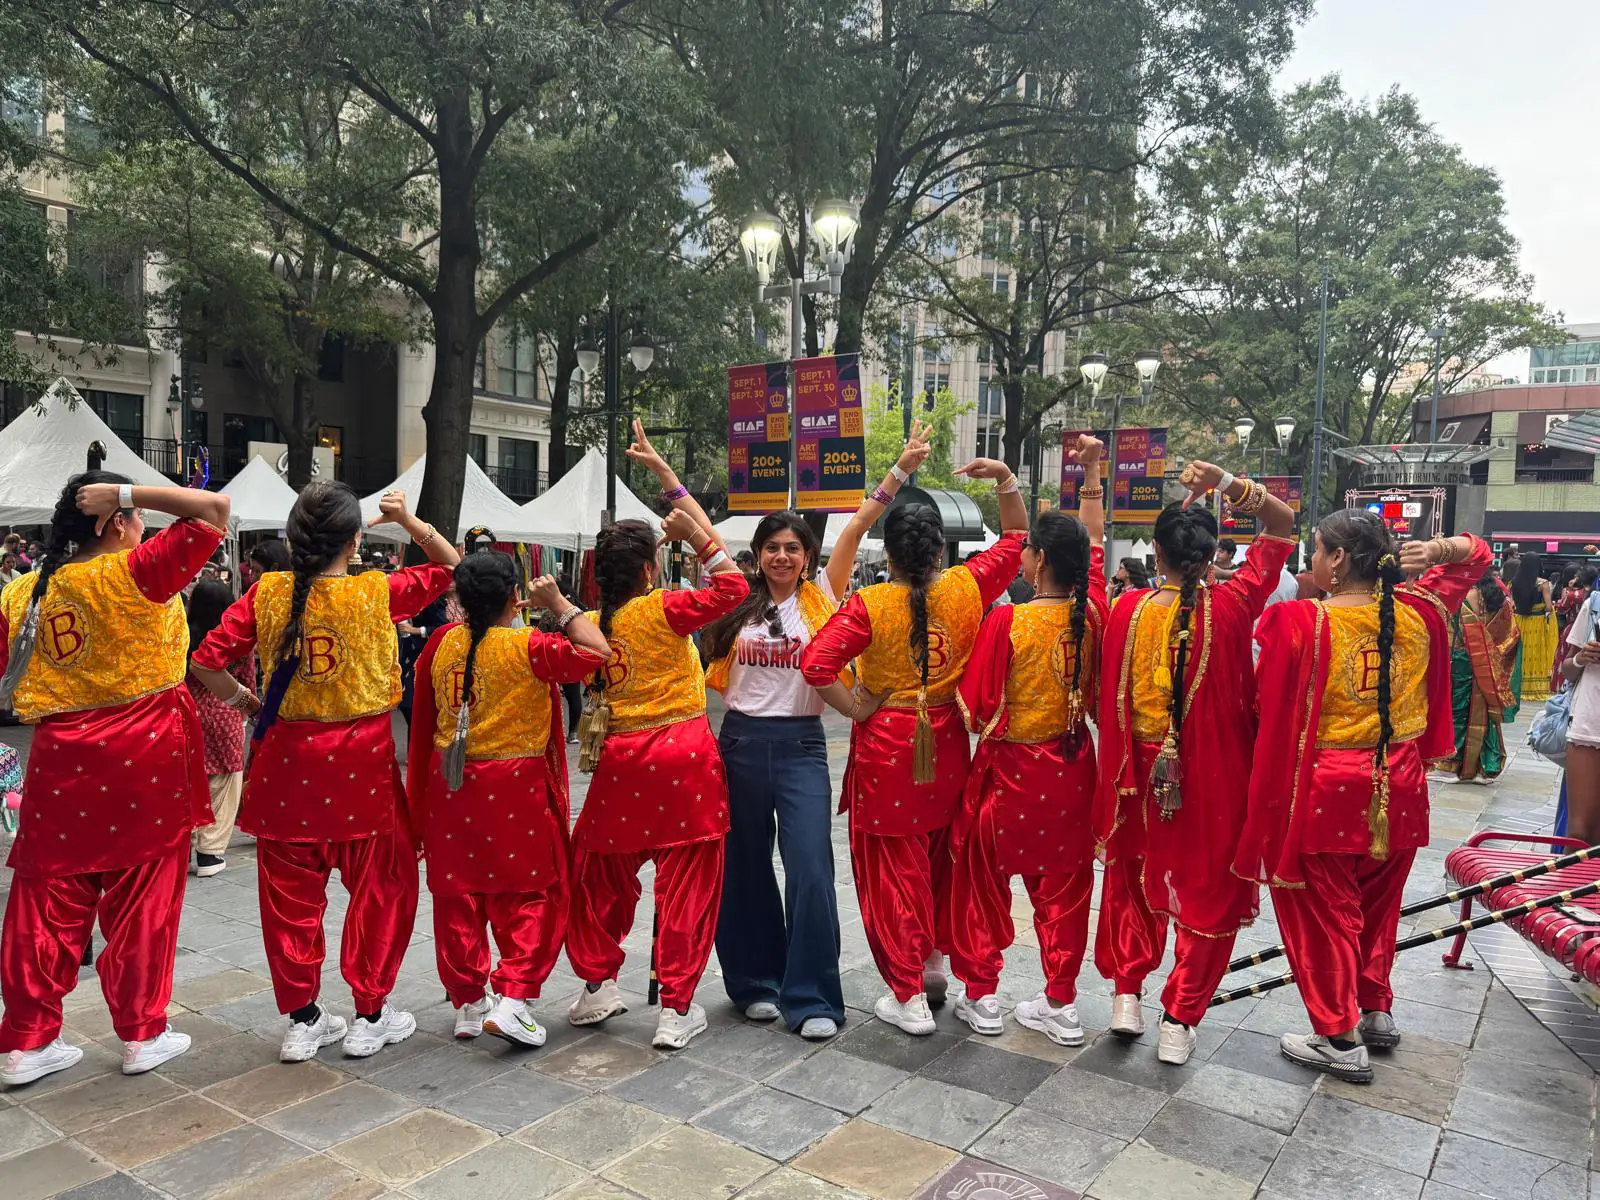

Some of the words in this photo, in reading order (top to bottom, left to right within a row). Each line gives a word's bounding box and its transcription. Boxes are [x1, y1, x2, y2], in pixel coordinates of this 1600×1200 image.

[800, 371, 825, 381] SEPT.
[827, 370, 831, 378] 1
[734, 377, 756, 388] SEPT.
[758, 377, 761, 385] 1
[798, 384, 822, 394] SEPT.
[824, 383, 835, 392] 30
[731, 391, 753, 400] SEPT.
[754, 390, 764, 398] 30
[733, 420, 764, 432] CIAF
[801, 415, 836, 427] CIAF
[731, 448, 746, 456] ART
[799, 443, 817, 451] ART
[752, 456, 782, 467] 200+
[823, 451, 857, 464] 200+
[752, 468, 786, 477] EVENTS
[823, 464, 861, 475] EVENTS
[1395, 472, 1441, 484] PERFORMING
[1132, 486, 1157, 494] 200+
[47, 611, 83, 661] B
[306, 636, 337, 677] B
[604, 647, 628, 690] B
